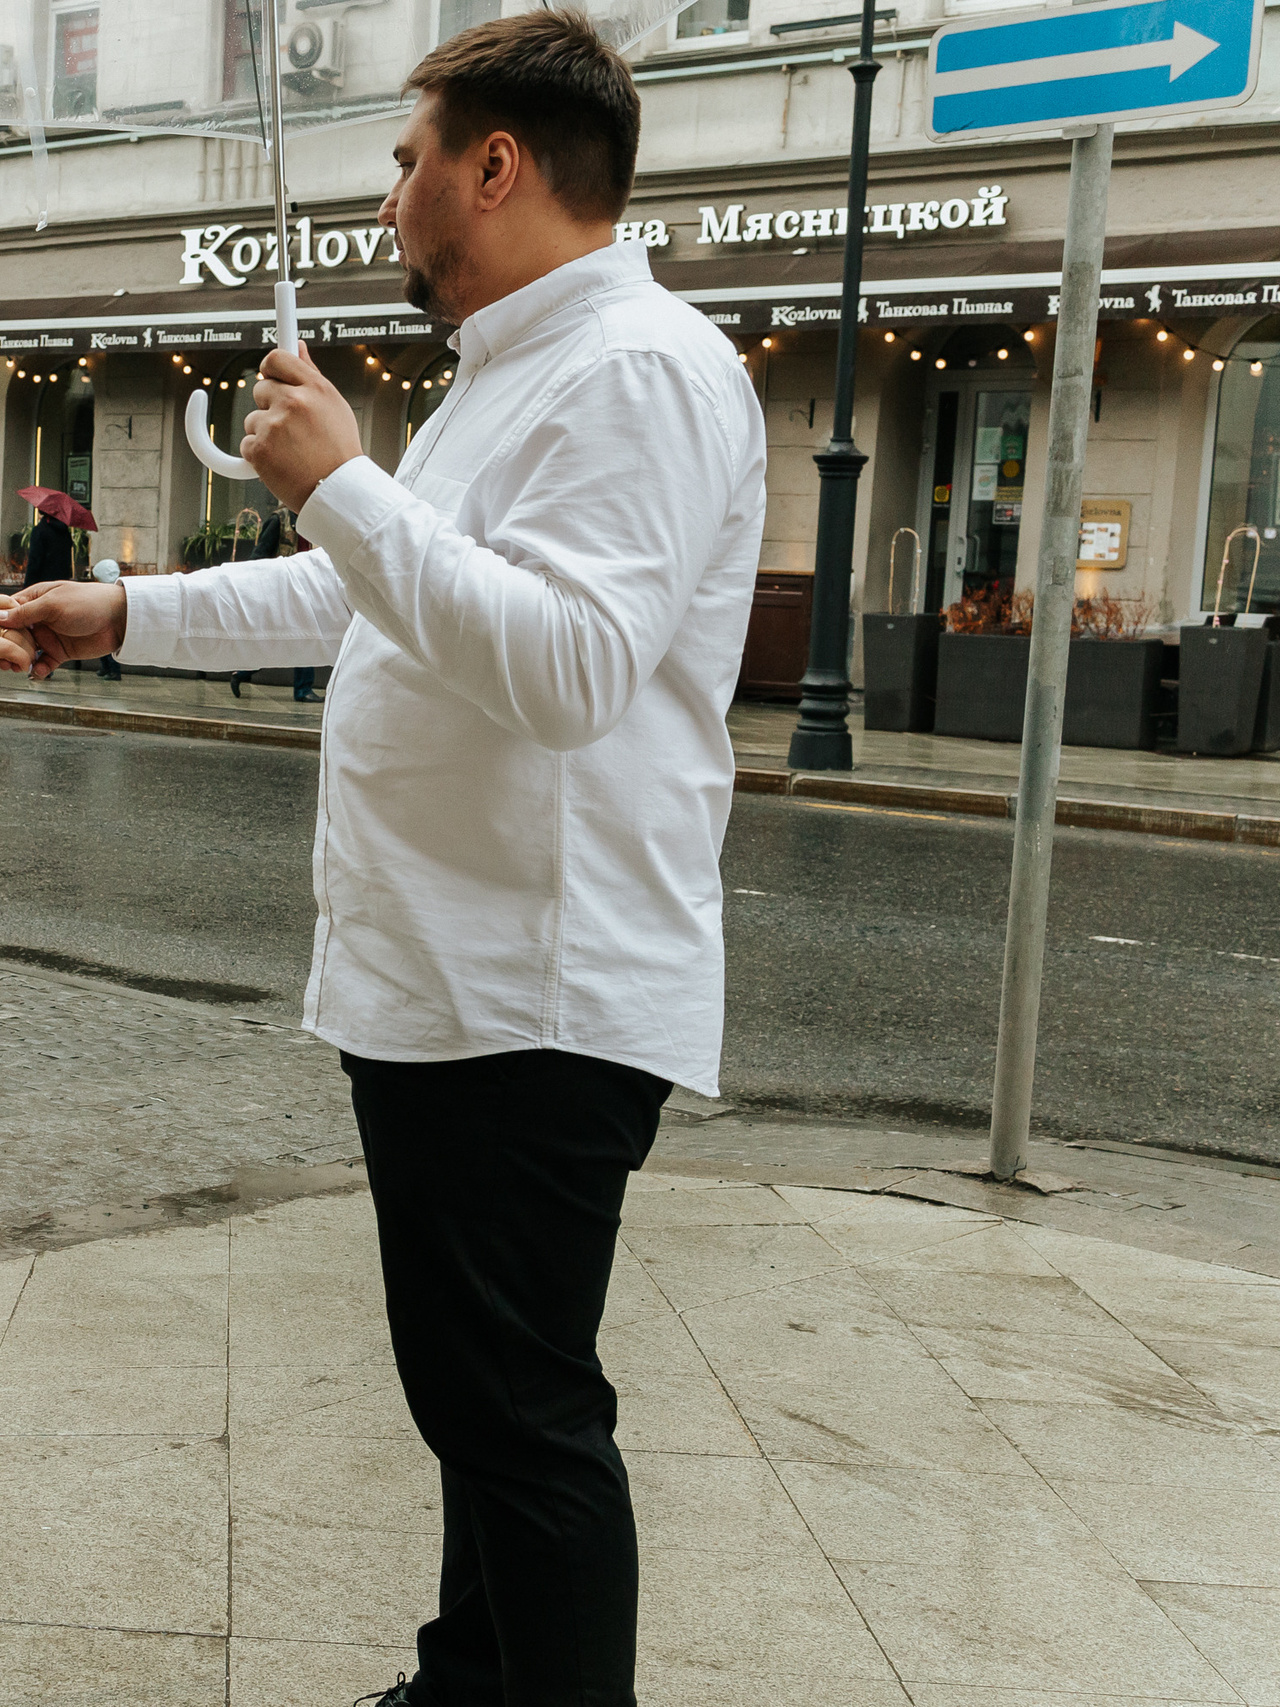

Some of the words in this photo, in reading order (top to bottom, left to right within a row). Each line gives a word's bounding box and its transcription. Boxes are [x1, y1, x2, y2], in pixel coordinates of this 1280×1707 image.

[1172, 288, 1257, 307] Танковая
[876, 300, 949, 318] Танковая
[952, 298, 1014, 315] Пивная
[90, 333, 138, 349] Kozlovna
[157, 330, 202, 344] Танковая
[203, 328, 242, 342] Пивная
[335, 323, 387, 338] Танковая
[388, 320, 432, 335] Пивная
